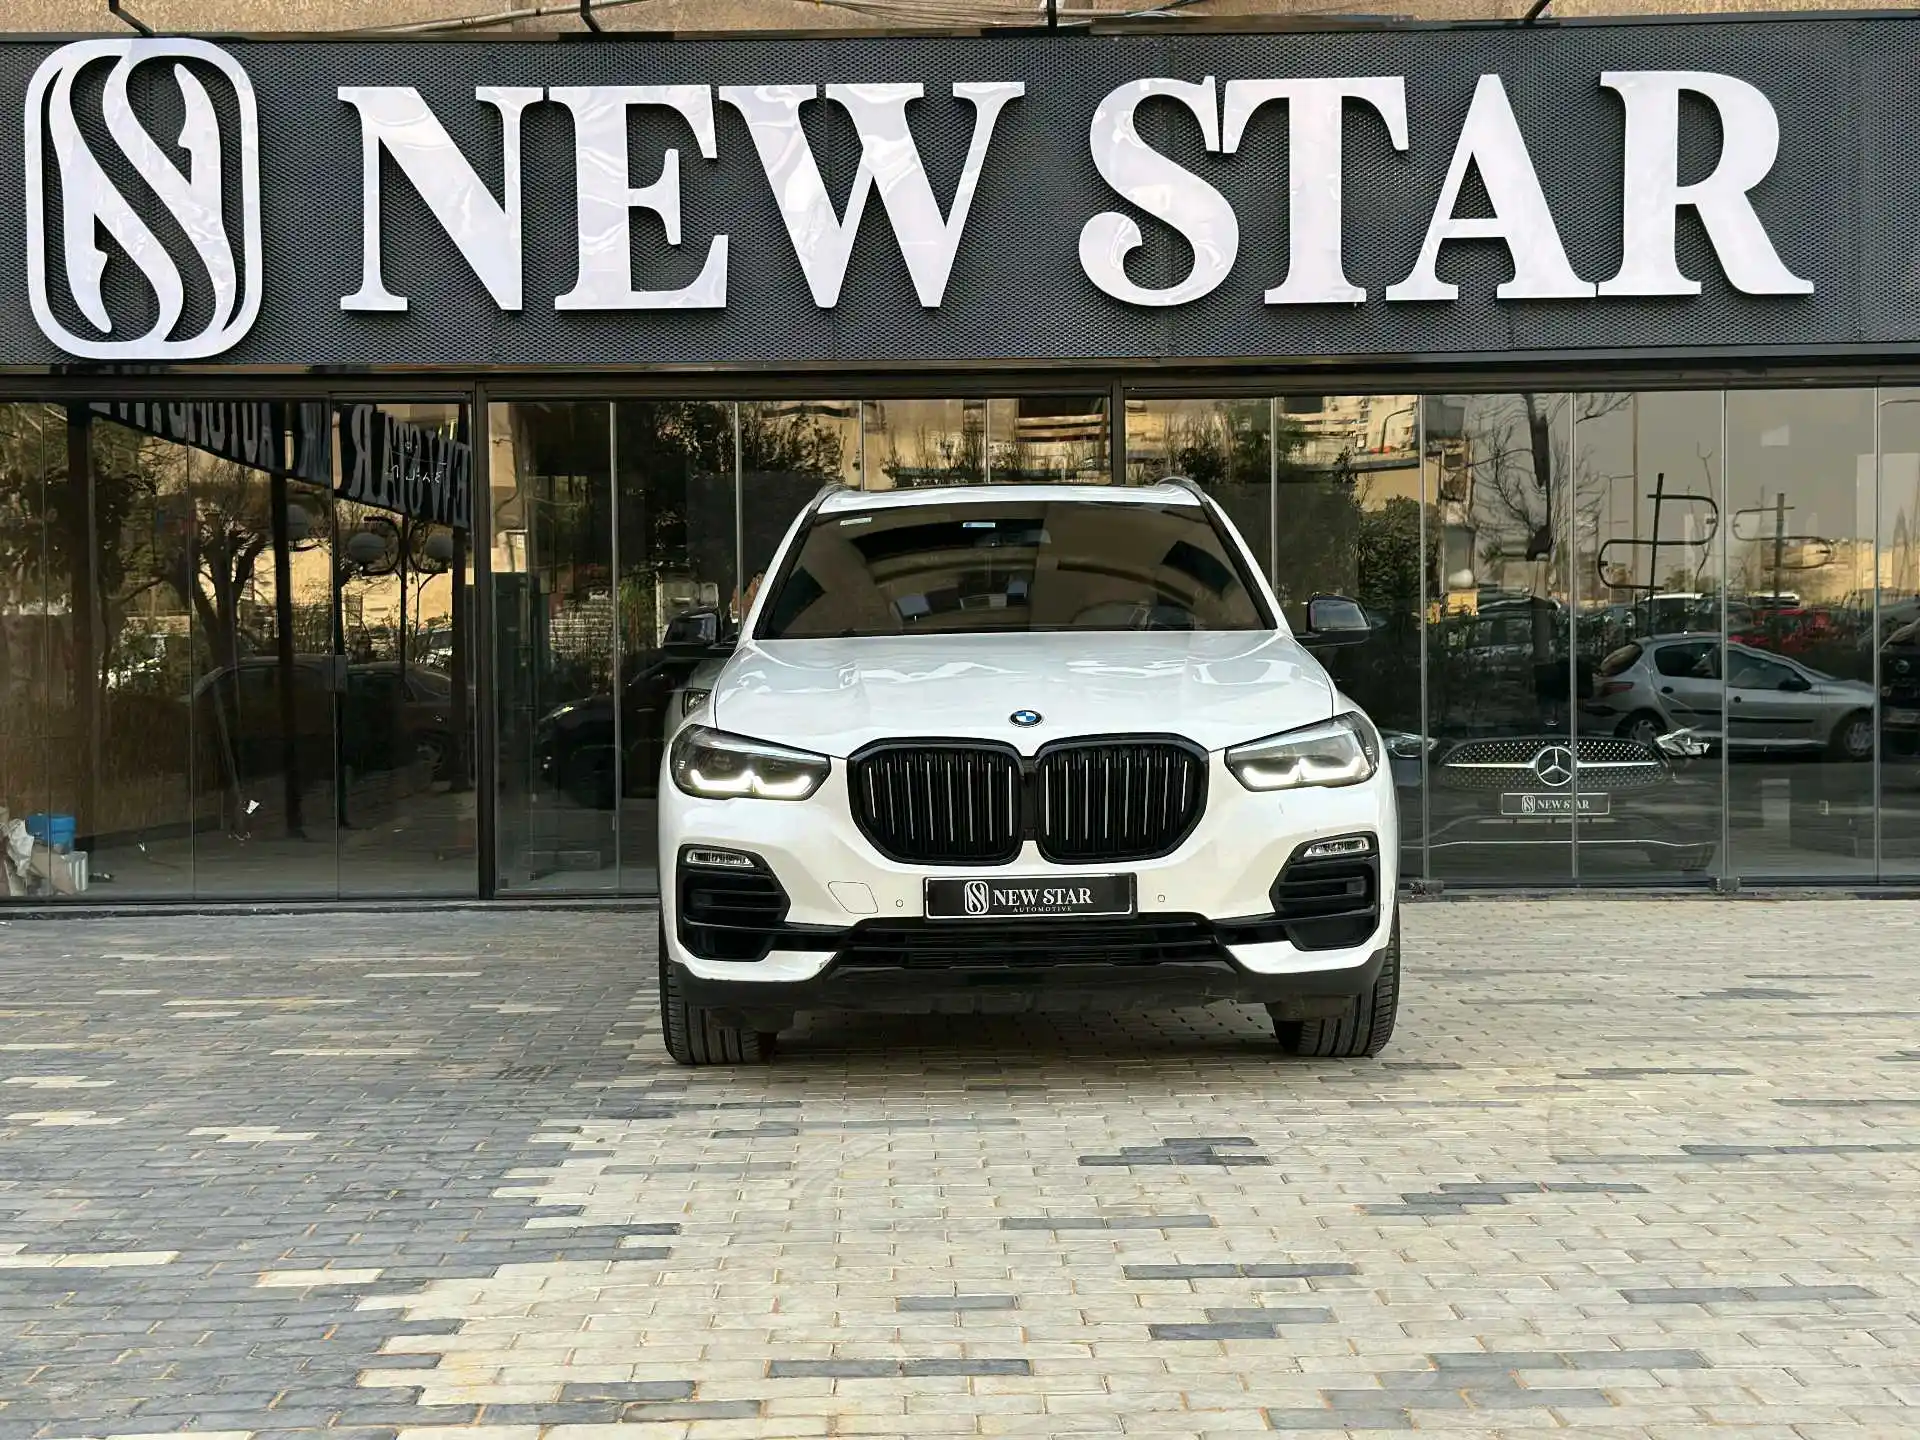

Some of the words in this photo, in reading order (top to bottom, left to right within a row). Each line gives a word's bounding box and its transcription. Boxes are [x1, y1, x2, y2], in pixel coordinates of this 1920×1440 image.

[337, 82, 1026, 312] NEW
[1078, 71, 1815, 308] STAR
[1537, 799, 1563, 809] NEW
[1563, 799, 1590, 809] SAR
[992, 888, 1042, 906] NEW
[1042, 887, 1093, 905] STAR
[1012, 905, 1073, 913] AUTOMOTIVE
